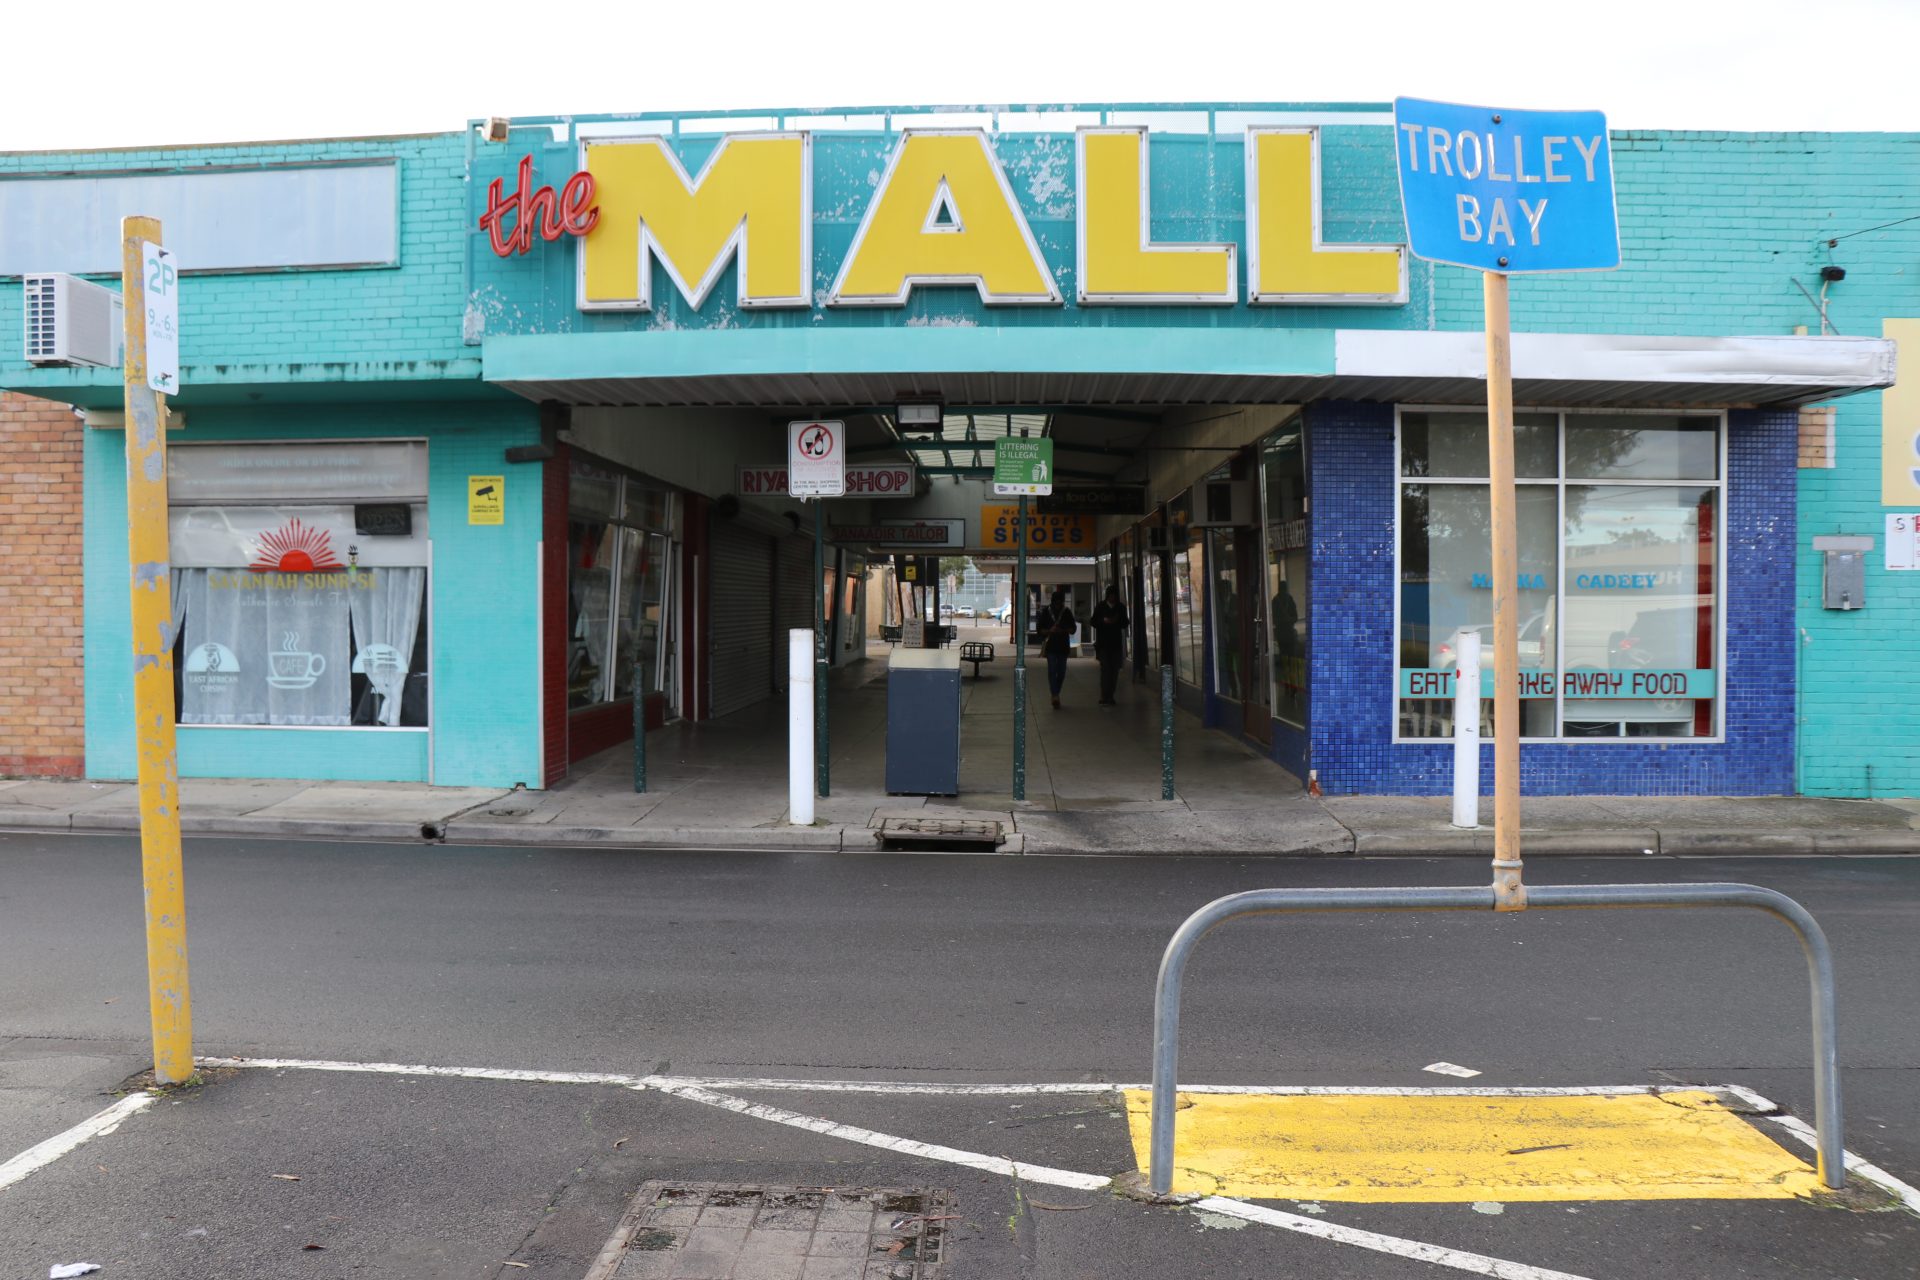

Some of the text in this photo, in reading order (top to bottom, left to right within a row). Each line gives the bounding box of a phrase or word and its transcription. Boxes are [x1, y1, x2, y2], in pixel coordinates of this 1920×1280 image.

[1400, 122, 1602, 183] TROLLEY
[479, 125, 1410, 311] the MALL
[1456, 193, 1548, 247] BAY
[148, 258, 175, 297] 2P
[999, 443, 1039, 451] LITTERING
[1000, 451, 1039, 459] IS ILLEGAL
[845, 470, 909, 493] SHOP
[359, 511, 407, 528] OPEN
[901, 527, 945, 541] TAILOR
[993, 528, 1084, 543] SHOES
[208, 573, 378, 590] SAVANNAH SUNRSE
[1471, 573, 1546, 590] MKA
[1576, 574, 1658, 589] CADEEY
[279, 657, 304, 673] CAFE
[188, 675, 207, 684] EAST
[1563, 672, 1623, 695] AWAY
[1632, 672, 1688, 695] FOOD
